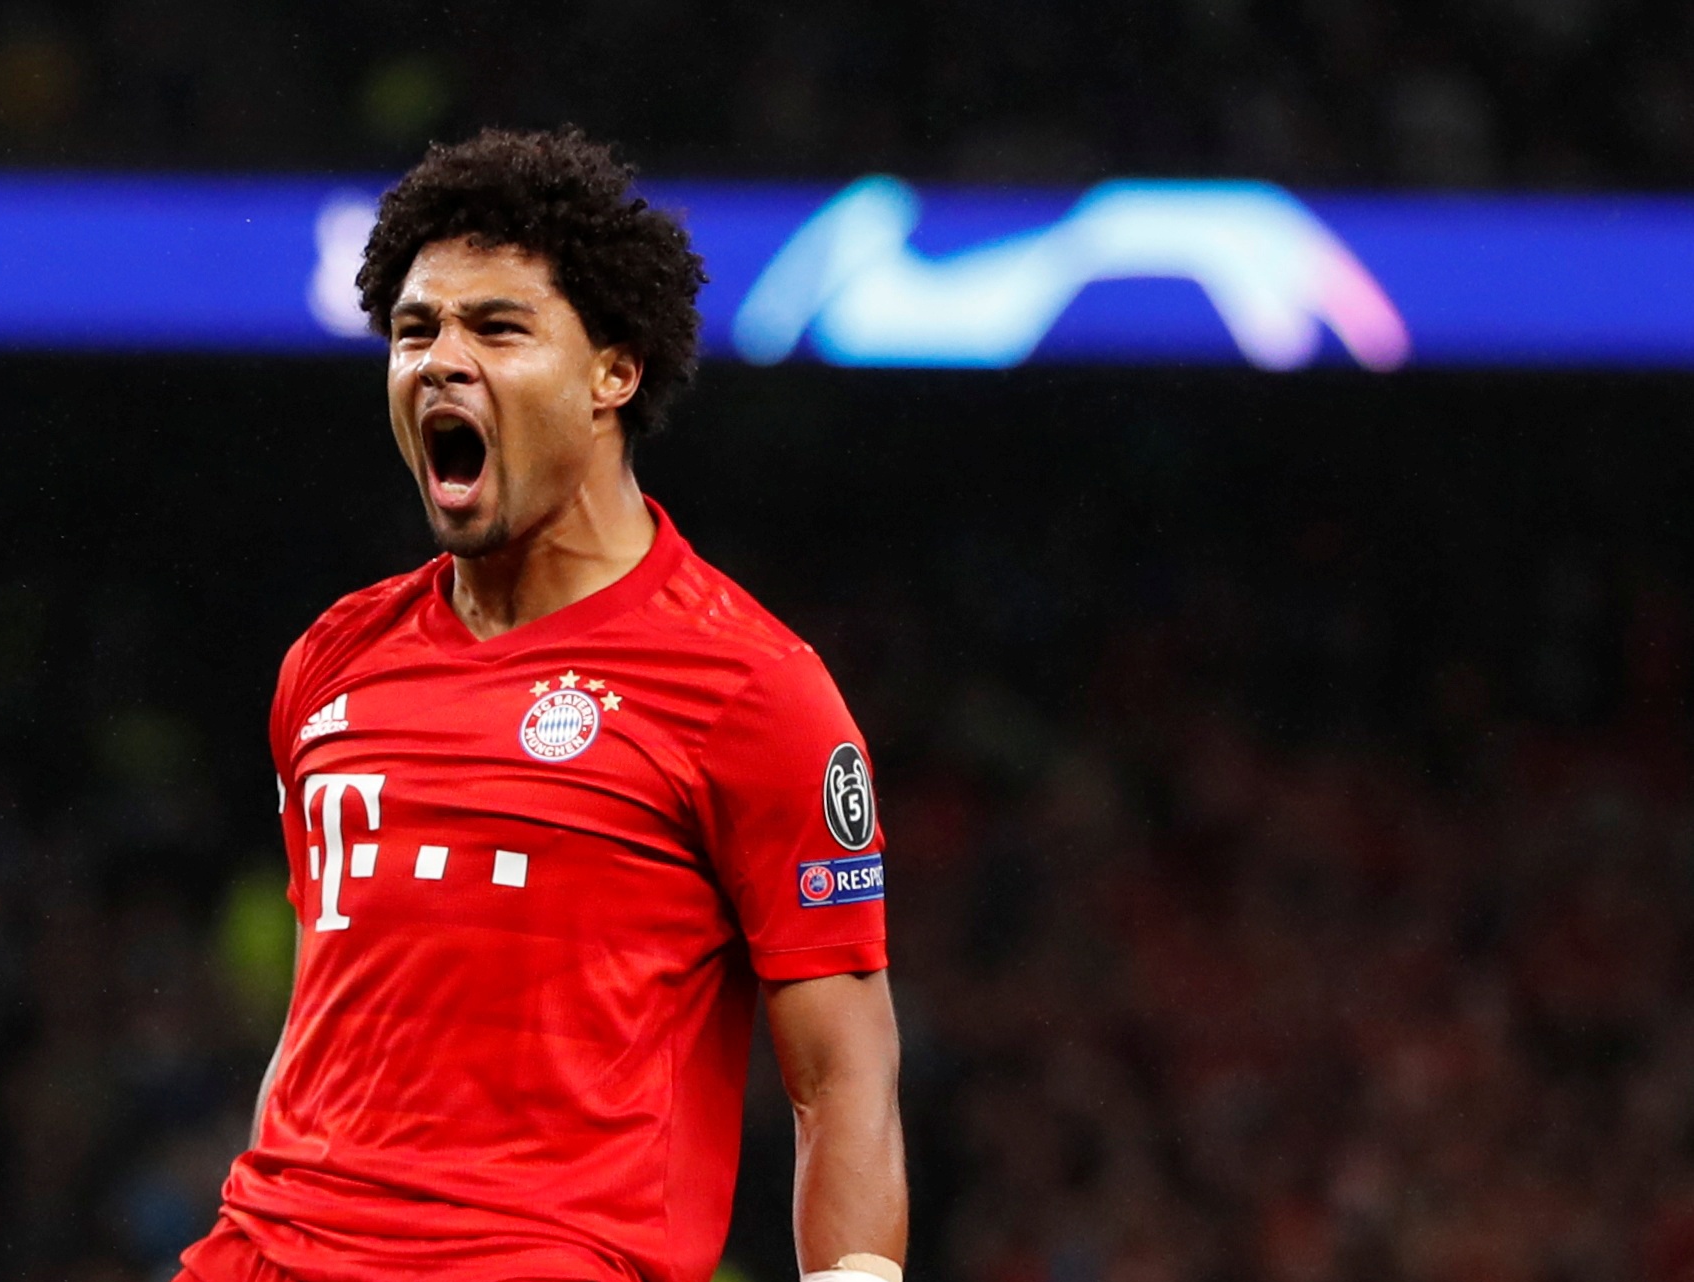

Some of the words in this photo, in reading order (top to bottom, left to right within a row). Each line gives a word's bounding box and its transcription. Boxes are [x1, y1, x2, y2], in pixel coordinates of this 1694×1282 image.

[533, 700, 552, 718] FC
[554, 694, 594, 726] BAYERN
[300, 720, 349, 740] adidas
[848, 793, 861, 821] 5
